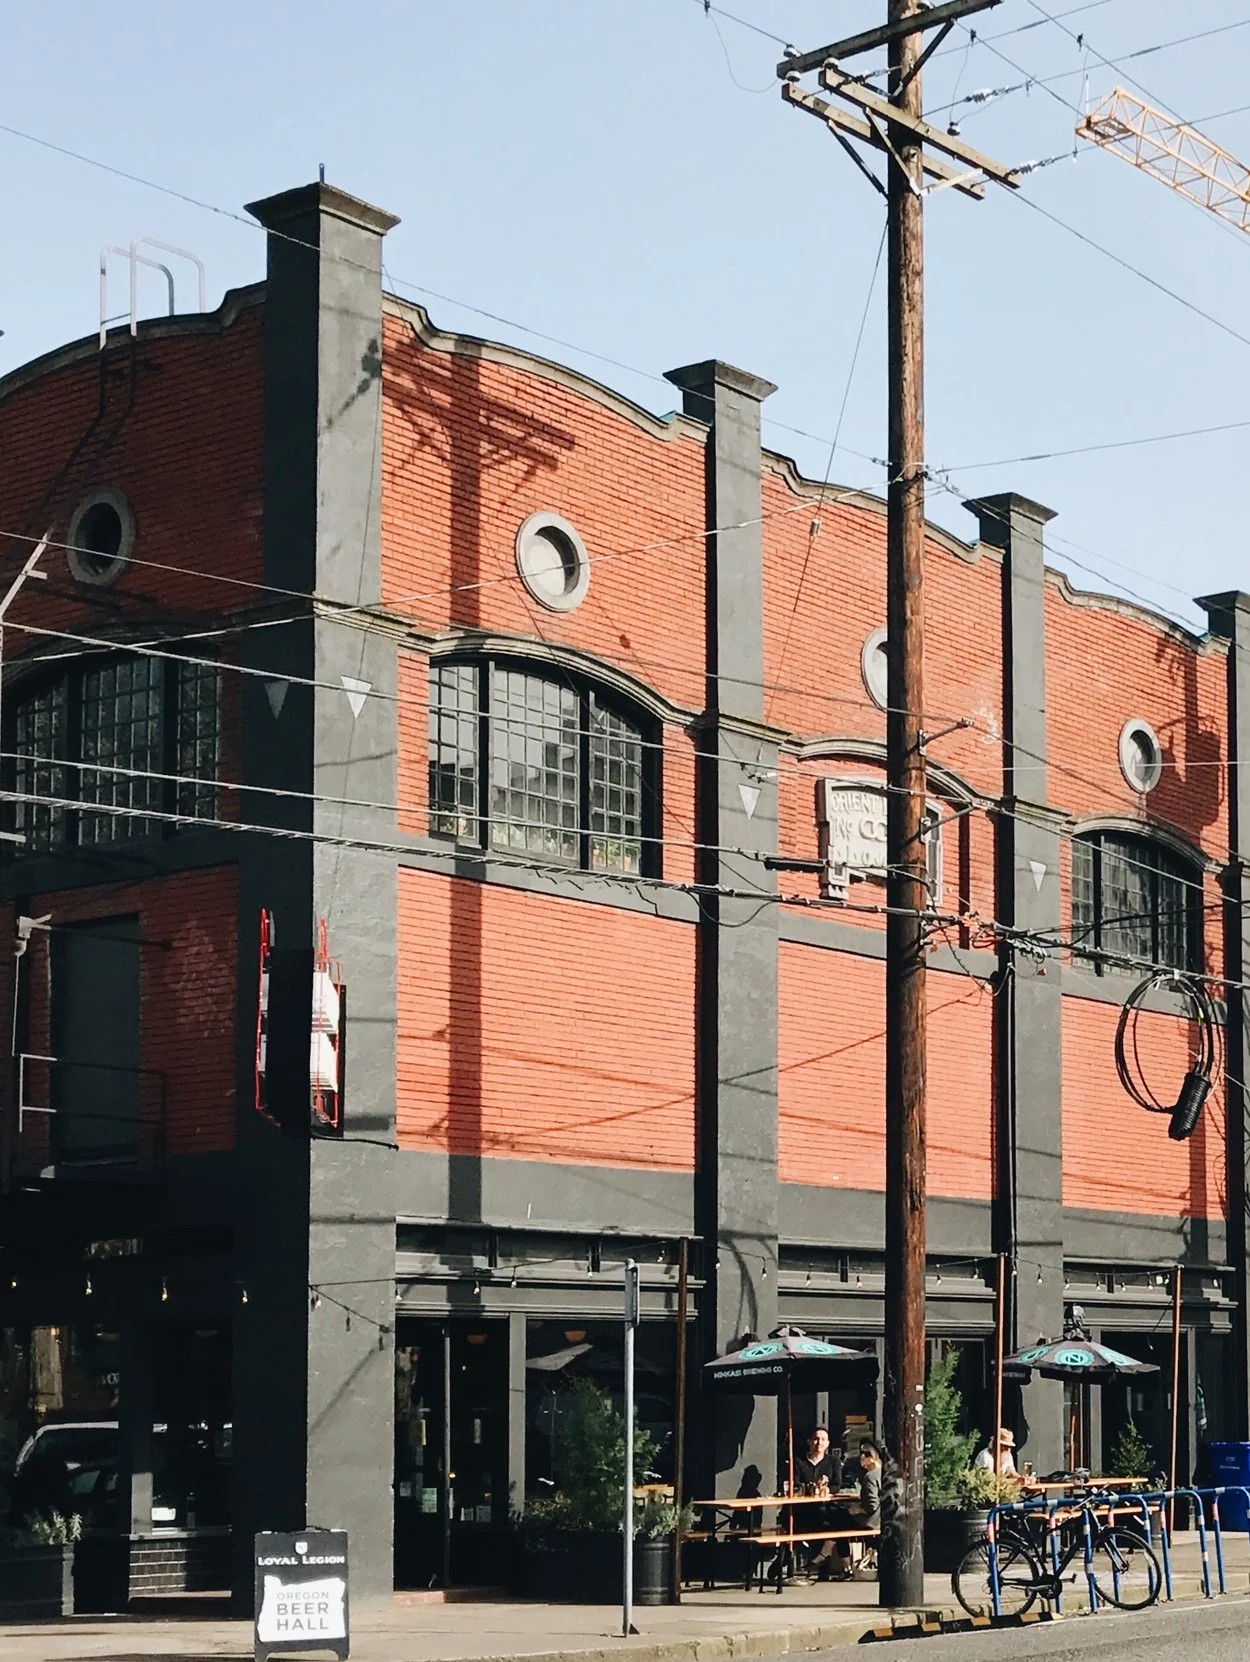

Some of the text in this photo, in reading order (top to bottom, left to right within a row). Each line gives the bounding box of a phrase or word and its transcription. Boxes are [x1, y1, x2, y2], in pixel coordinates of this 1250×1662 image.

[257, 1555, 345, 1566] LOYAL LEGION
[277, 1592, 329, 1600] OREGON
[277, 1602, 329, 1616] BEER
[277, 1617, 329, 1631] HALL
